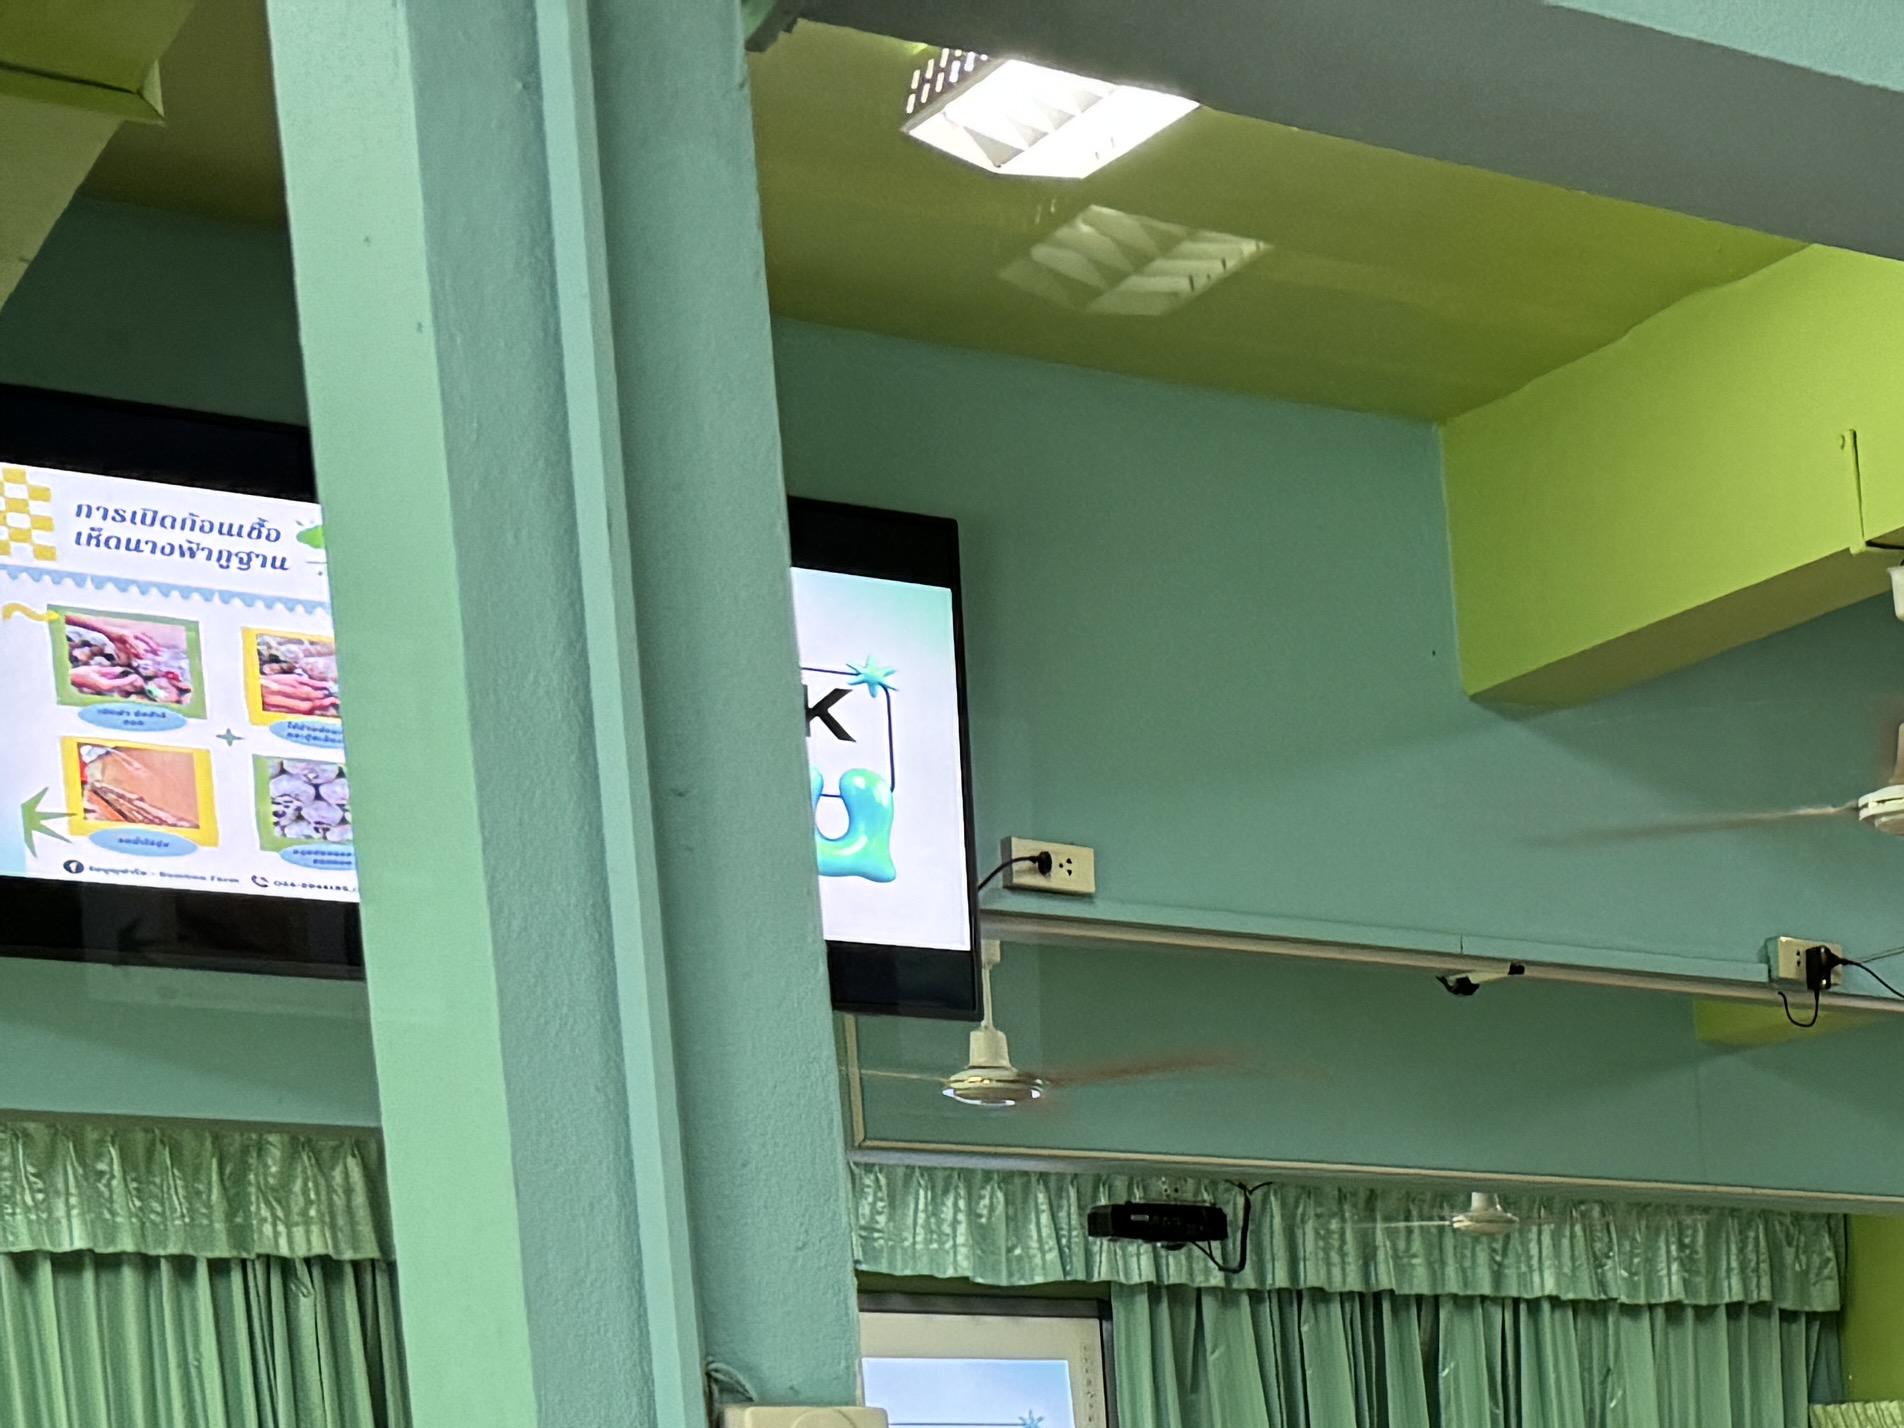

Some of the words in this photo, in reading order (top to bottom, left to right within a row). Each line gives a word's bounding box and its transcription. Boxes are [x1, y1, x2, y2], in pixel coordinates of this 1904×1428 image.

[75, 502, 281, 543] การเปิดก้อนเชื้อ
